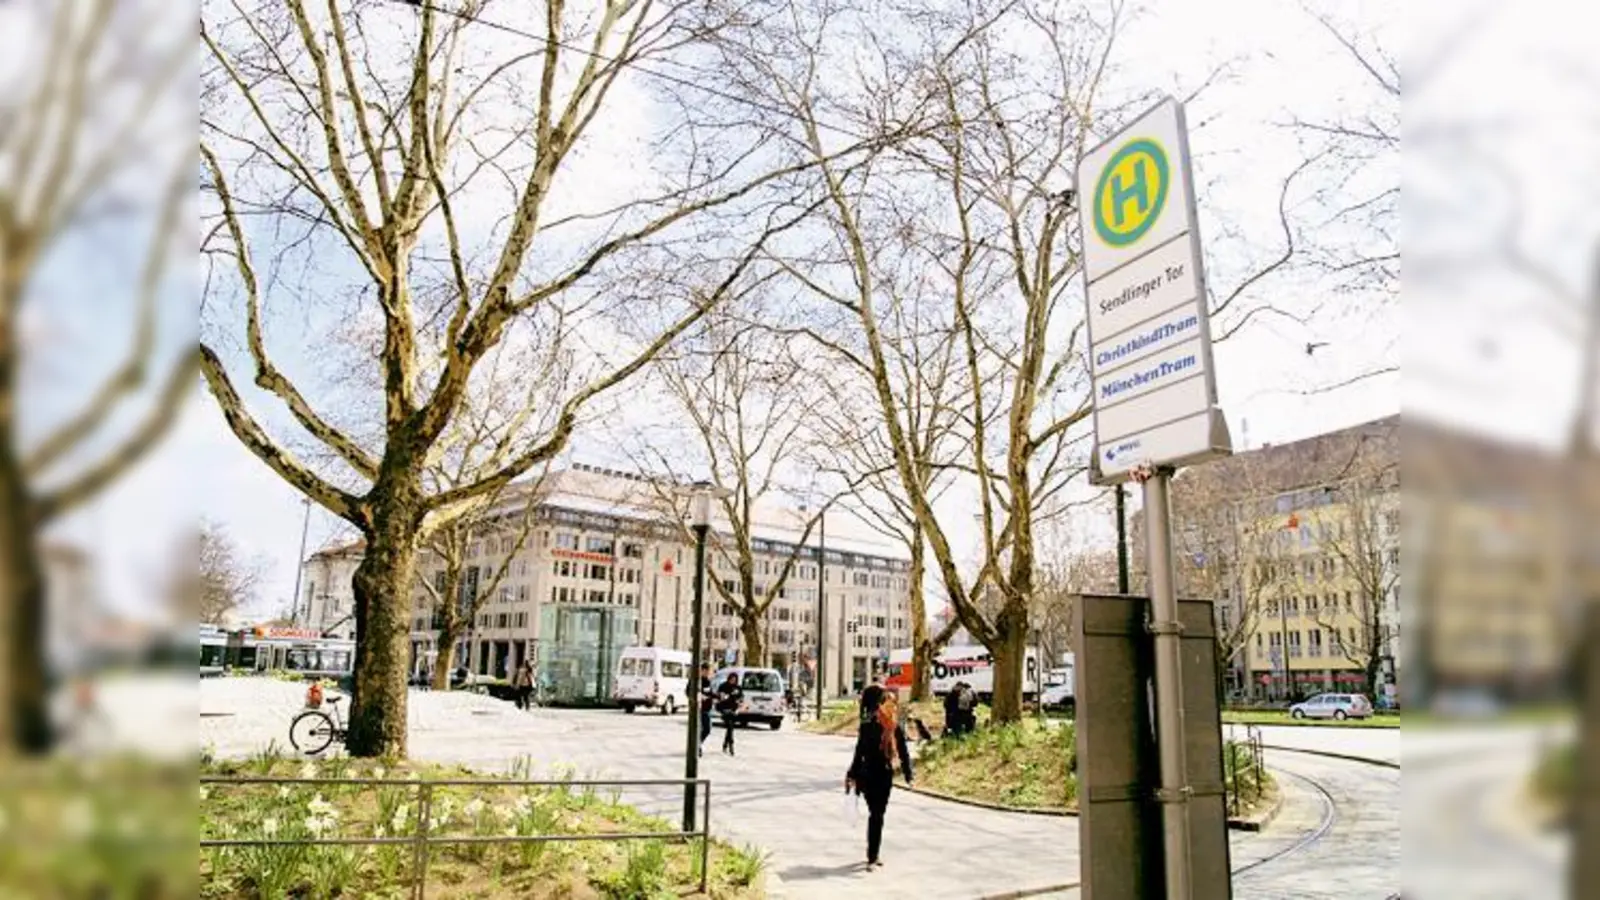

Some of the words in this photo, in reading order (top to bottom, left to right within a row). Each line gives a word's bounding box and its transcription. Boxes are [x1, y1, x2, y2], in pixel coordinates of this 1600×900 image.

[1111, 159, 1148, 226] H
[1099, 276, 1162, 316] Sendlinger
[1165, 265, 1184, 282] Tor
[1096, 316, 1198, 366] ChristkindlTram
[1101, 355, 1195, 399] MünchenTram
